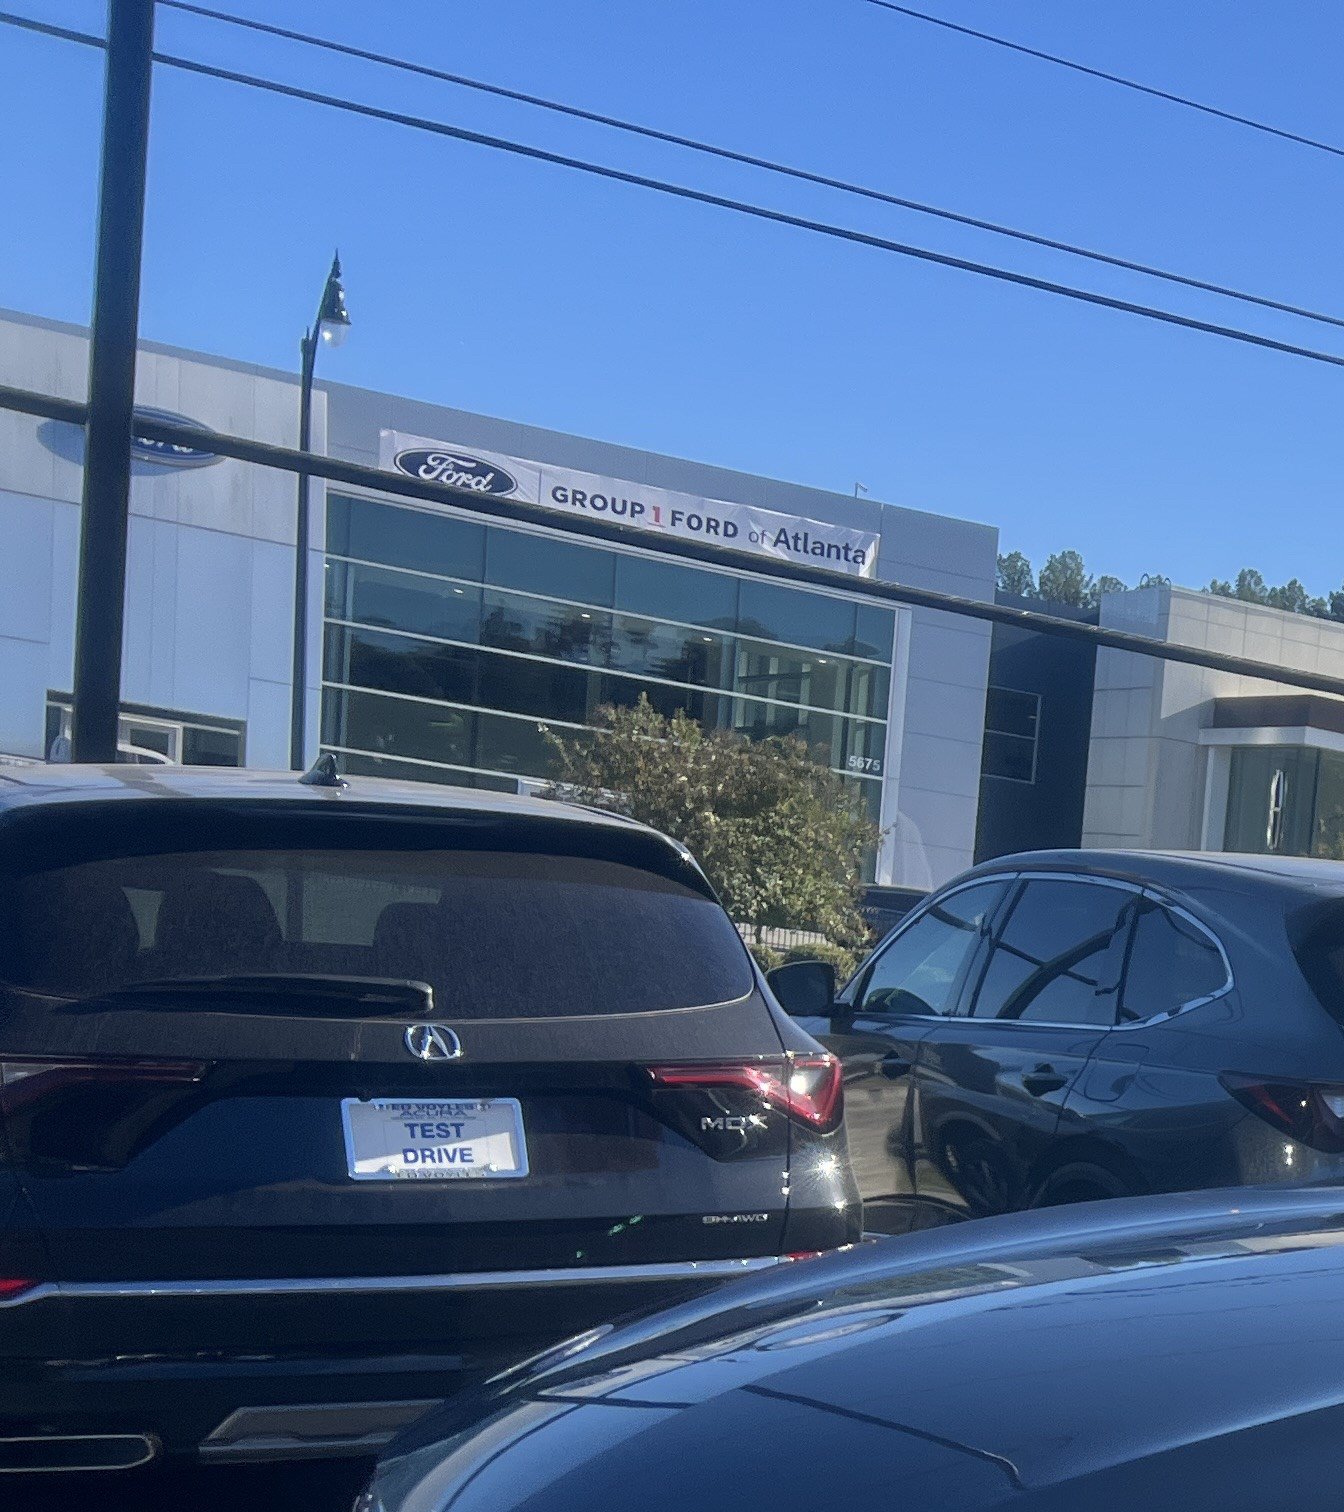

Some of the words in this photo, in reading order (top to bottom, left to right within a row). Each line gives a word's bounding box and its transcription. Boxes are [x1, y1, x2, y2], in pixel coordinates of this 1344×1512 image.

[418, 452, 495, 494] Ford
[551, 485, 645, 519] GROUP
[651, 505, 664, 525] 1
[670, 509, 738, 539] FORD
[748, 530, 767, 544] of
[773, 527, 866, 565] Atlanta
[848, 755, 880, 771] 5675
[404, 1122, 465, 1139] TEST
[403, 1147, 475, 1164] DRIVE
